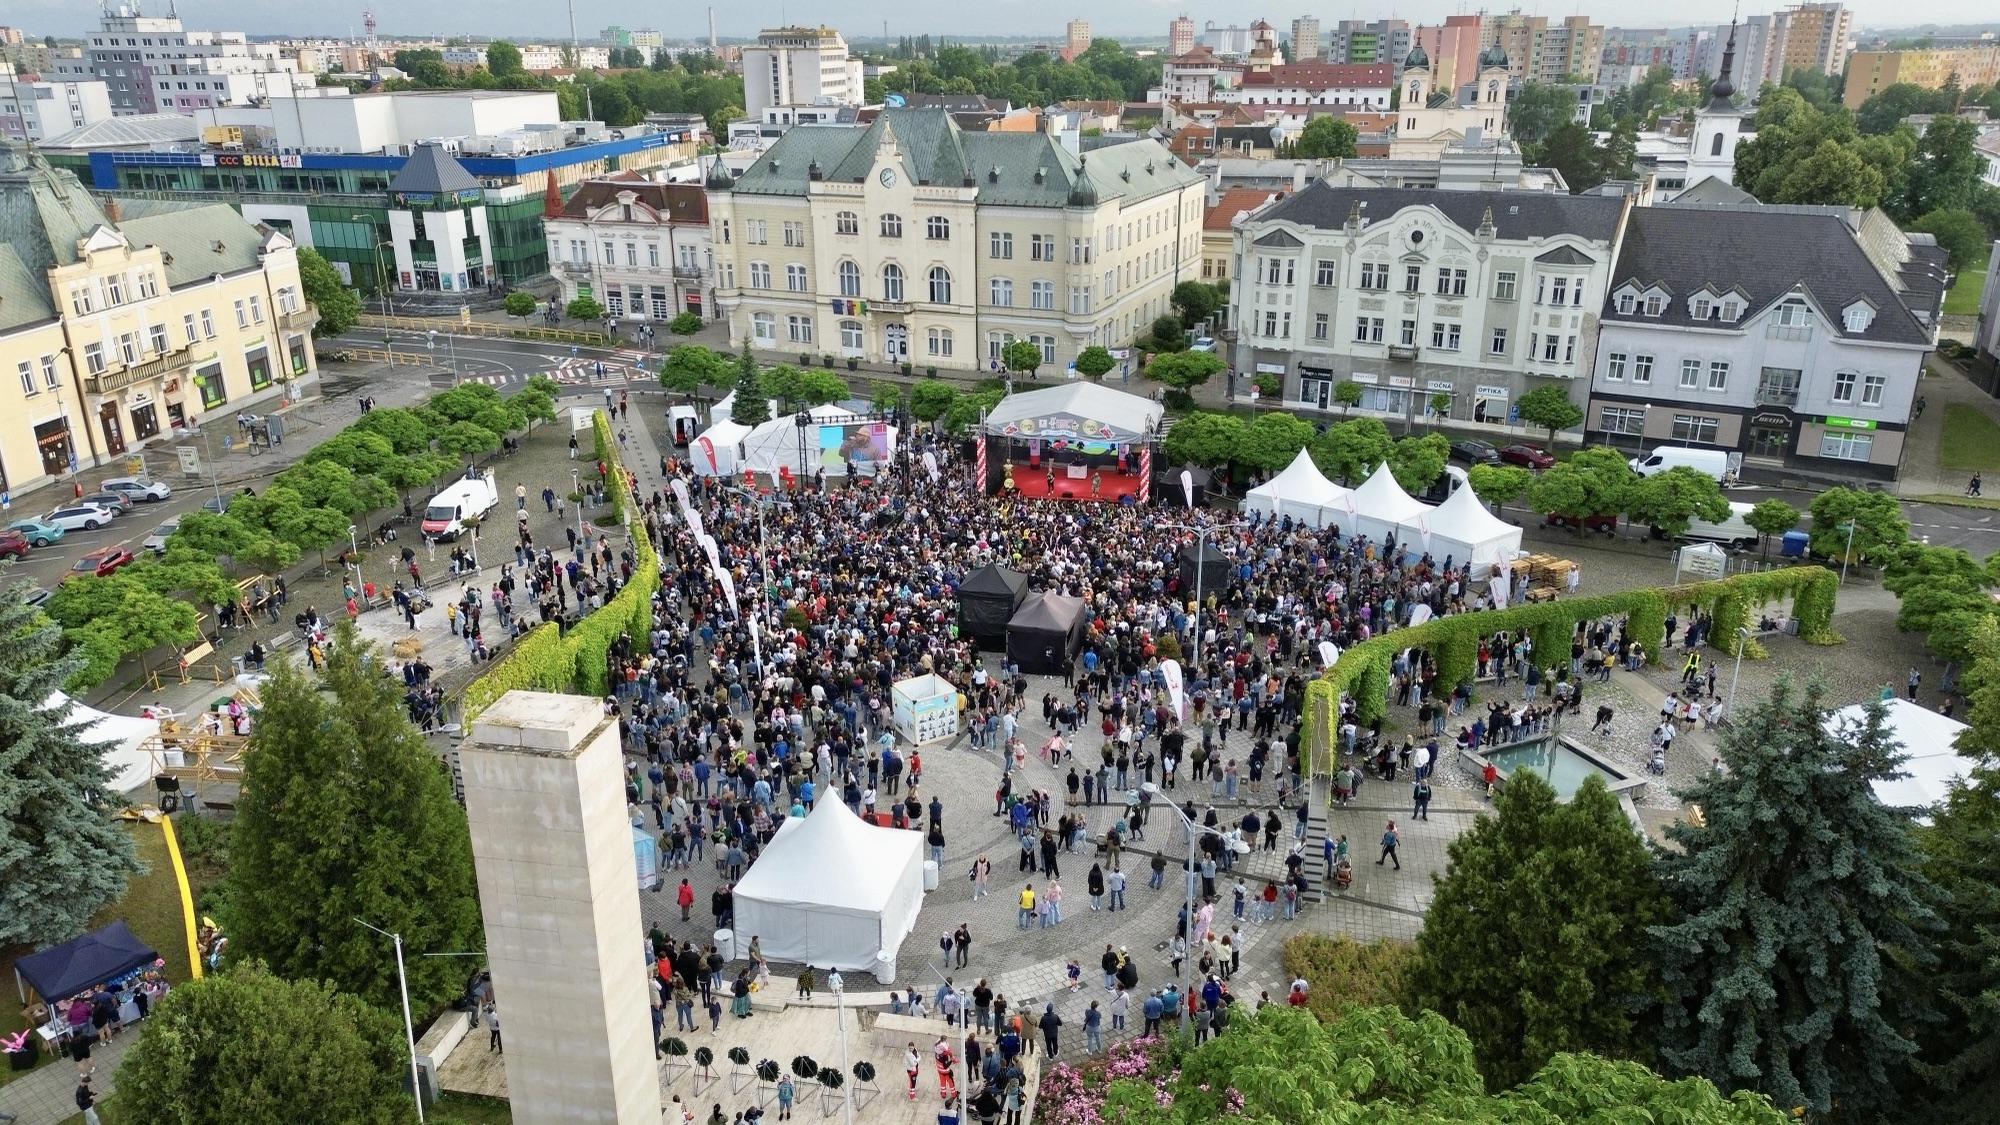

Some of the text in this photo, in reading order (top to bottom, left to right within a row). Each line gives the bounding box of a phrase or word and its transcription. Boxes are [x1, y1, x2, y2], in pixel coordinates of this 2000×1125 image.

[219, 157, 239, 165] CCC
[242, 154, 280, 167] BILLA
[1433, 382, 1452, 390] OČNÁ
[1477, 387, 1502, 395] OPTIKA
